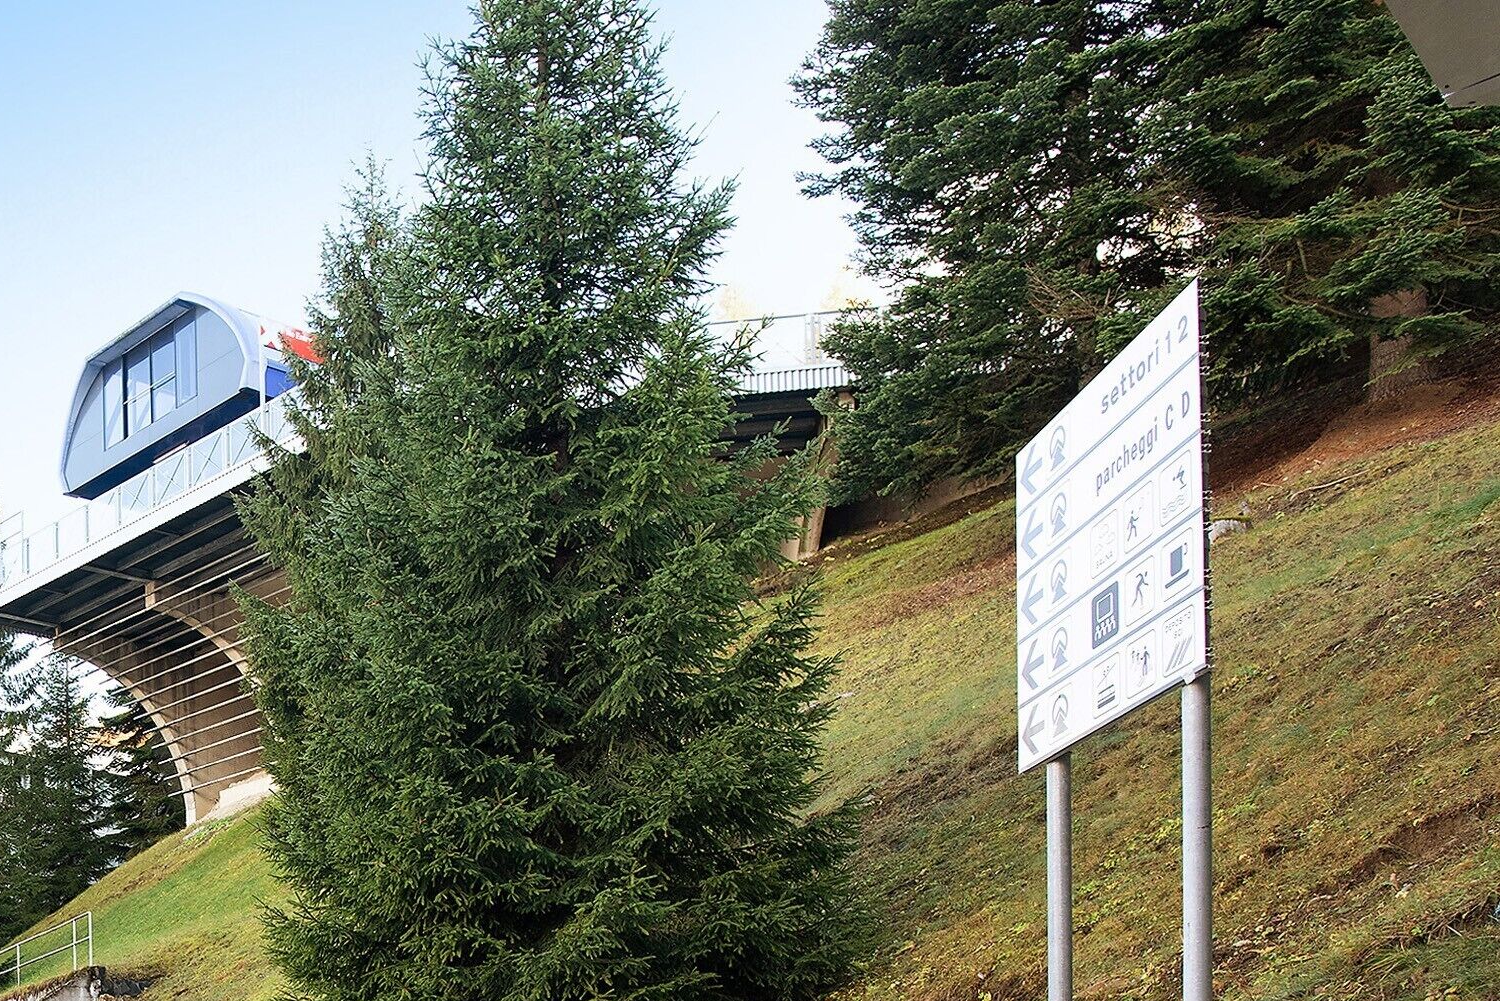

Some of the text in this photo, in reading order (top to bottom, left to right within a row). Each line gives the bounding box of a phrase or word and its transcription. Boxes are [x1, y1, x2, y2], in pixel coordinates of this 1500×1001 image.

[1100, 315, 1188, 415] settori 1 2
[1095, 391, 1190, 497] parcheggi C D
